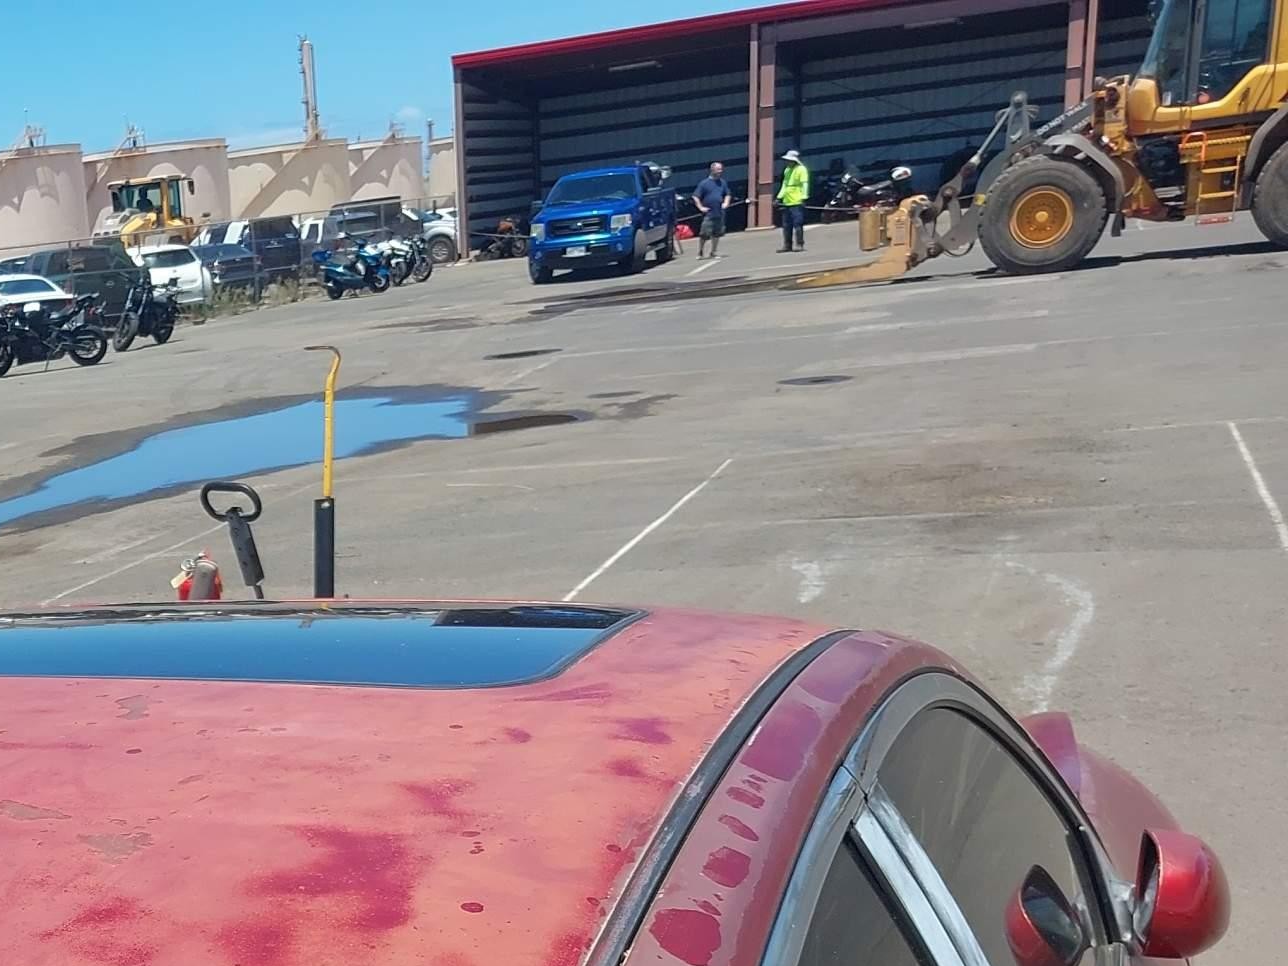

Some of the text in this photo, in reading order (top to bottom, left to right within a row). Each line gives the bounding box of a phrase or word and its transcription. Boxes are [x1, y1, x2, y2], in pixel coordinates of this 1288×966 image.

[1036, 101, 1088, 136] DO NOT WALK
